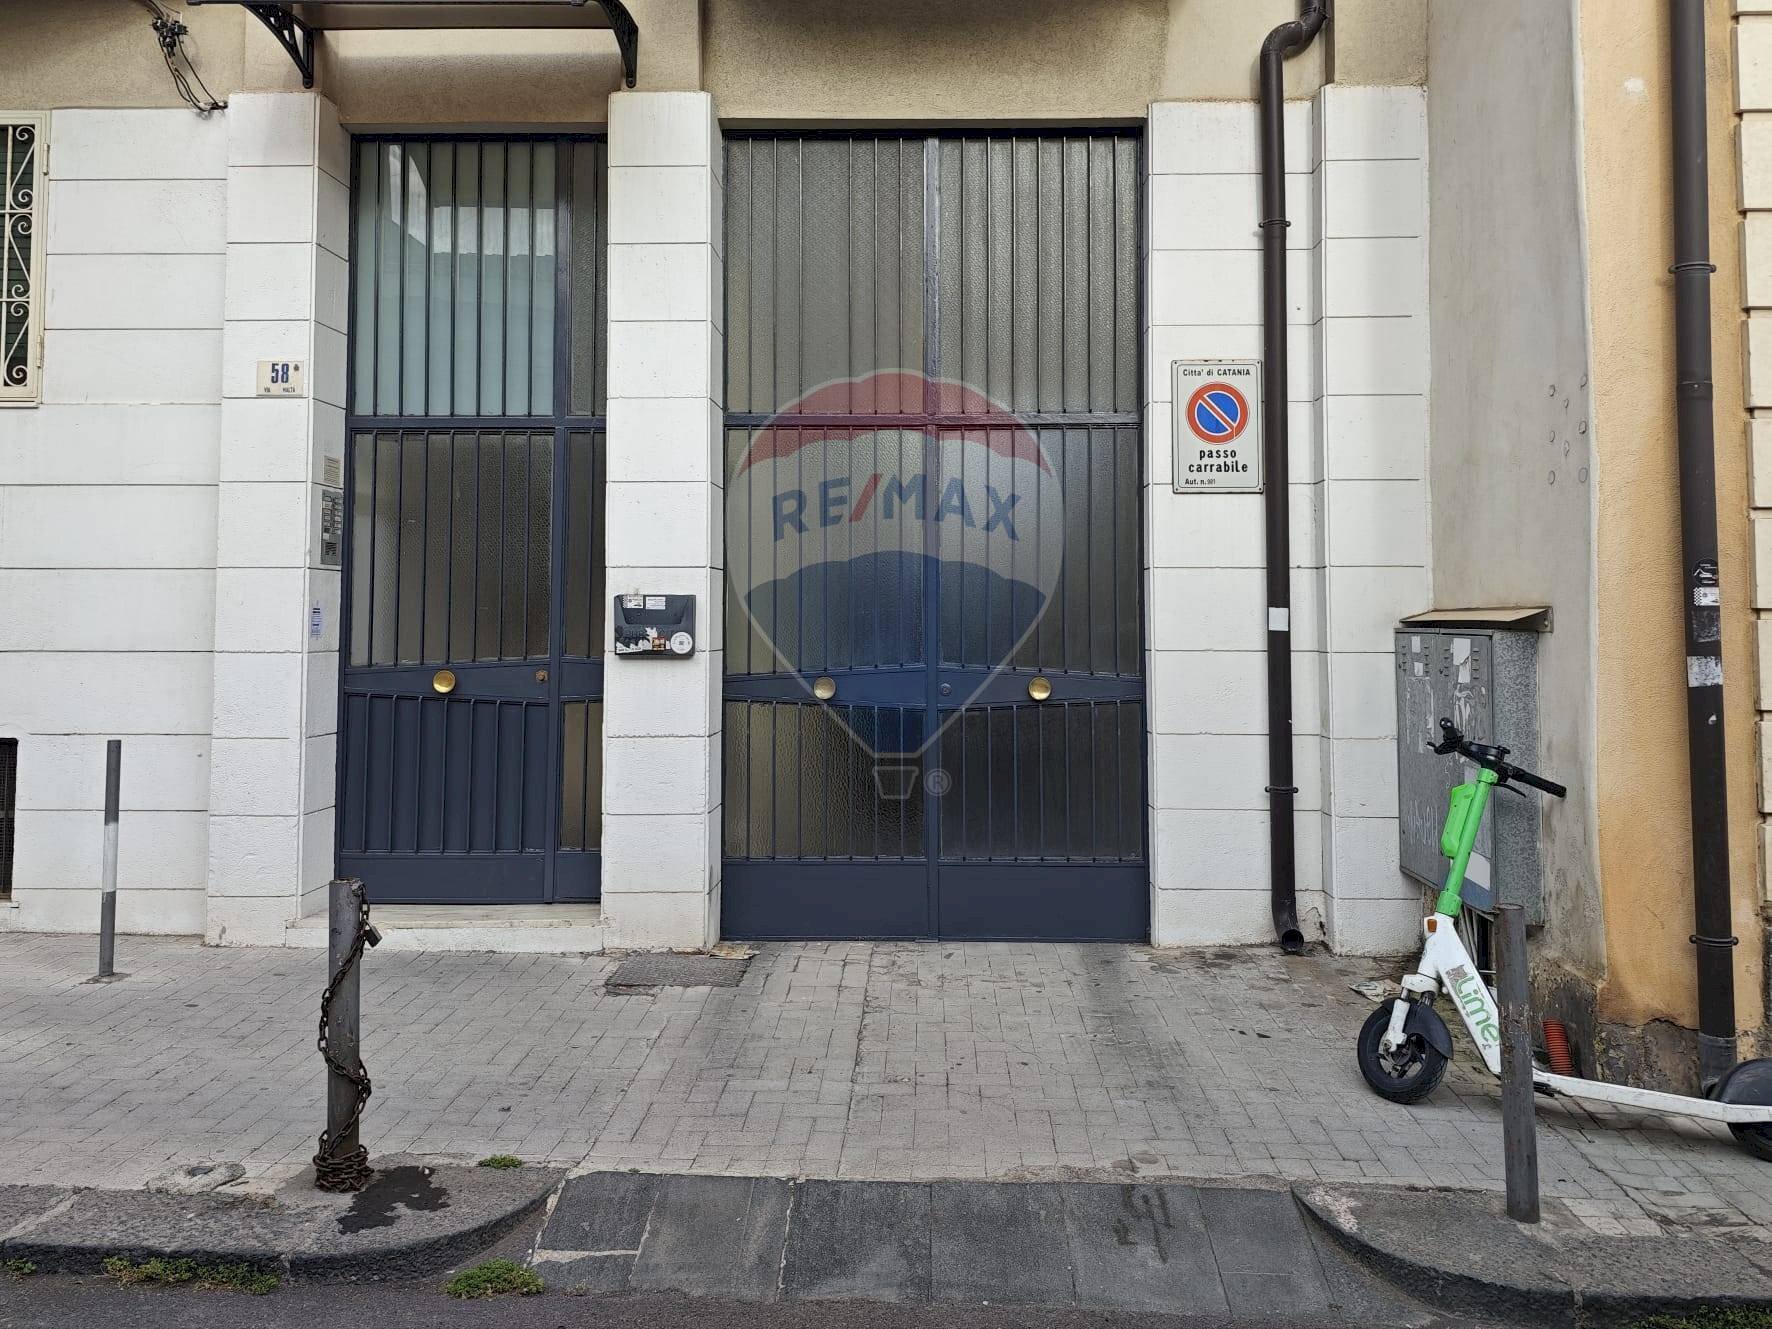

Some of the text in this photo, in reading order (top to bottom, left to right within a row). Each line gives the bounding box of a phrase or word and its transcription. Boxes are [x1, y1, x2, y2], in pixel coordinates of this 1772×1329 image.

[271, 362, 290, 384] 58
[1206, 368, 1214, 377] di
[1217, 368, 1251, 377] CATANIA
[1199, 449, 1237, 461] passo
[1188, 460, 1249, 473] carrabile
[1184, 478, 1199, 486] Aut.
[1455, 975, 1500, 1043] Lime
